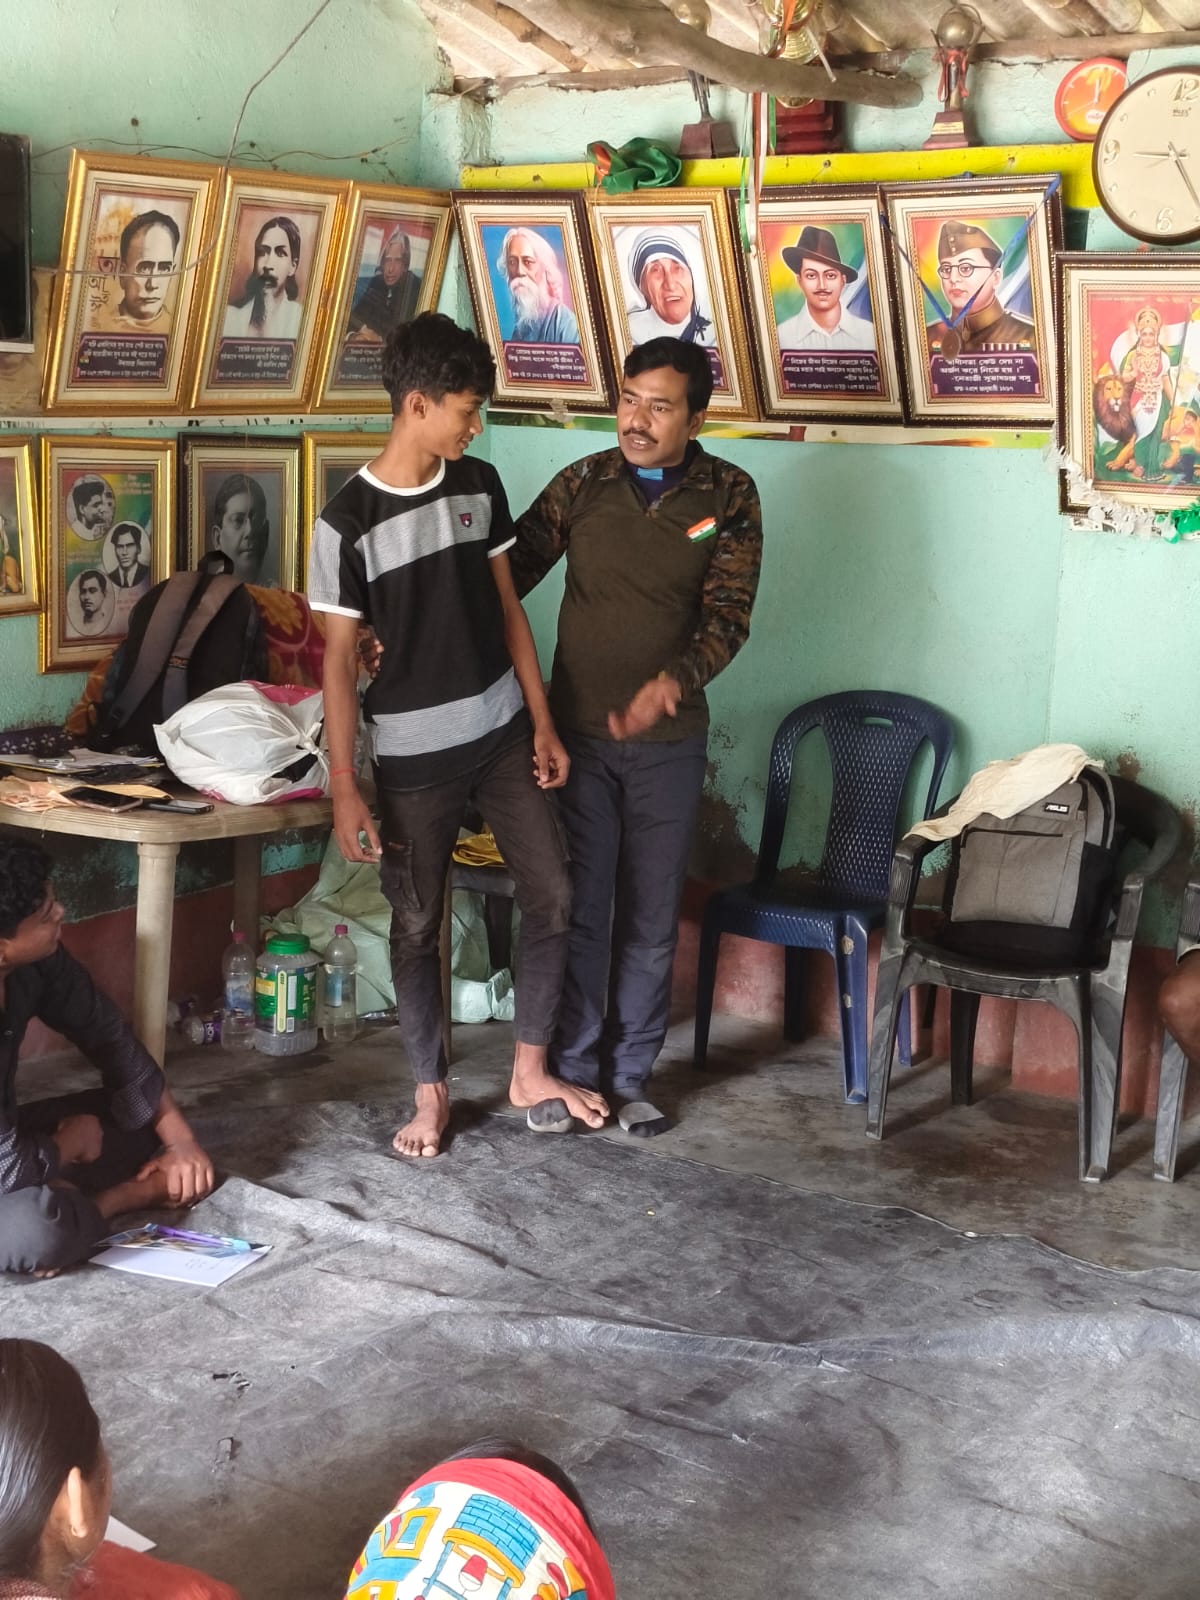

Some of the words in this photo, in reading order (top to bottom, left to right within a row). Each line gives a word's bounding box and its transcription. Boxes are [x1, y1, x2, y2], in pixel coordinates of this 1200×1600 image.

[1103, 139, 1121, 165] 9
[1156, 207, 1174, 233] 6
[1045, 804, 1068, 812] ASUS
